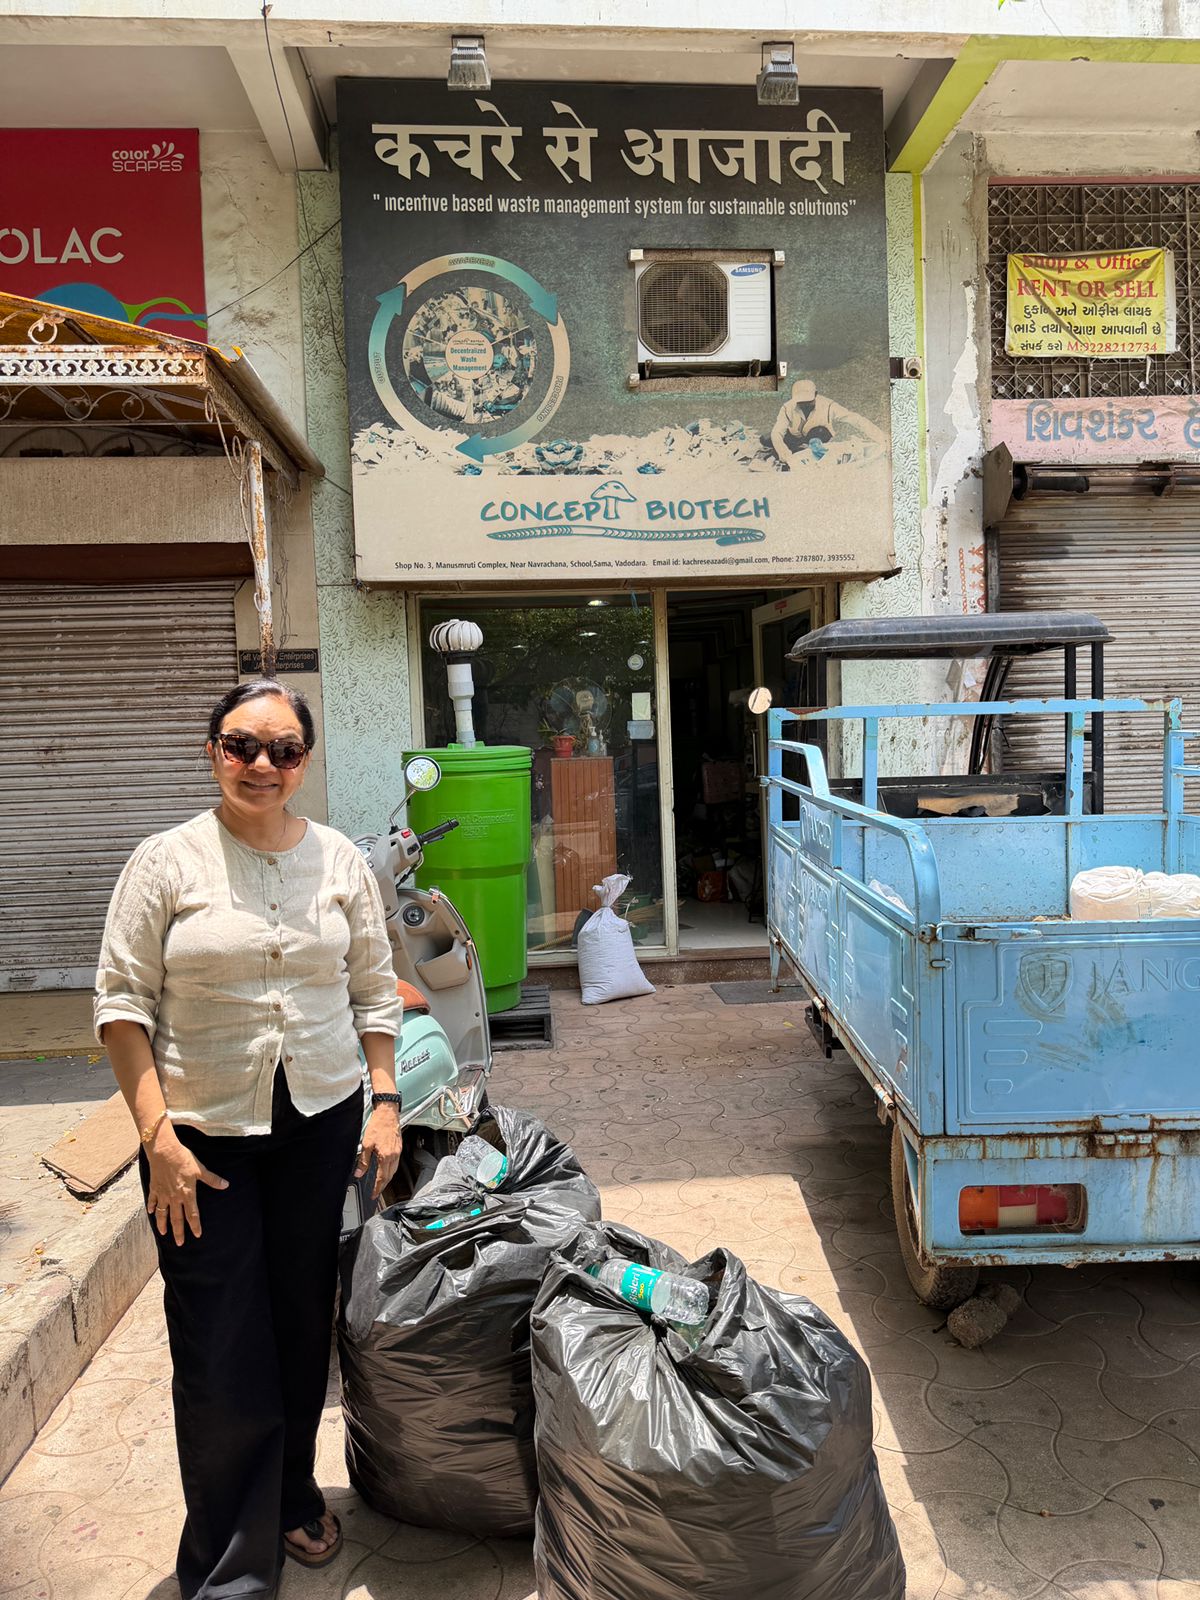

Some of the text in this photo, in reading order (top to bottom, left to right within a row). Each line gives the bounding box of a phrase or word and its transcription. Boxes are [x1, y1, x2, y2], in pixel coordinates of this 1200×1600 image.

[111, 149, 150, 160] color
[371, 98, 851, 195] कचरे से आजादी
[111, 160, 183, 172] SCAPES
[384, 194, 448, 212] incentive
[452, 194, 493, 213] based
[498, 195, 540, 213] waste
[544, 196, 630, 219] management
[634, 198, 683, 218] system
[687, 197, 706, 214] for
[709, 198, 785, 215] sustainable
[1016, 278, 1158, 298] RENT OR SELL
[1055, 302, 1077, 316] અને
[452, 364, 487, 372] Management
[537, 375, 564, 423] PROCESSING
[1025, 400, 1159, 442] શિવશંકર
[480, 480, 771, 522] CONCEPT BIOTECH
[394, 561, 412, 570] Shop
[413, 561, 425, 569] No.
[427, 561, 434, 570] 3,
[435, 560, 476, 569] Manusmruti
[477, 560, 508, 570] Complex,
[510, 560, 526, 569] Near
[527, 560, 568, 569] Navrachana,
[652, 558, 671, 566] Email
[672, 558, 681, 566] id:
[771, 555, 794, 564] Phone:
